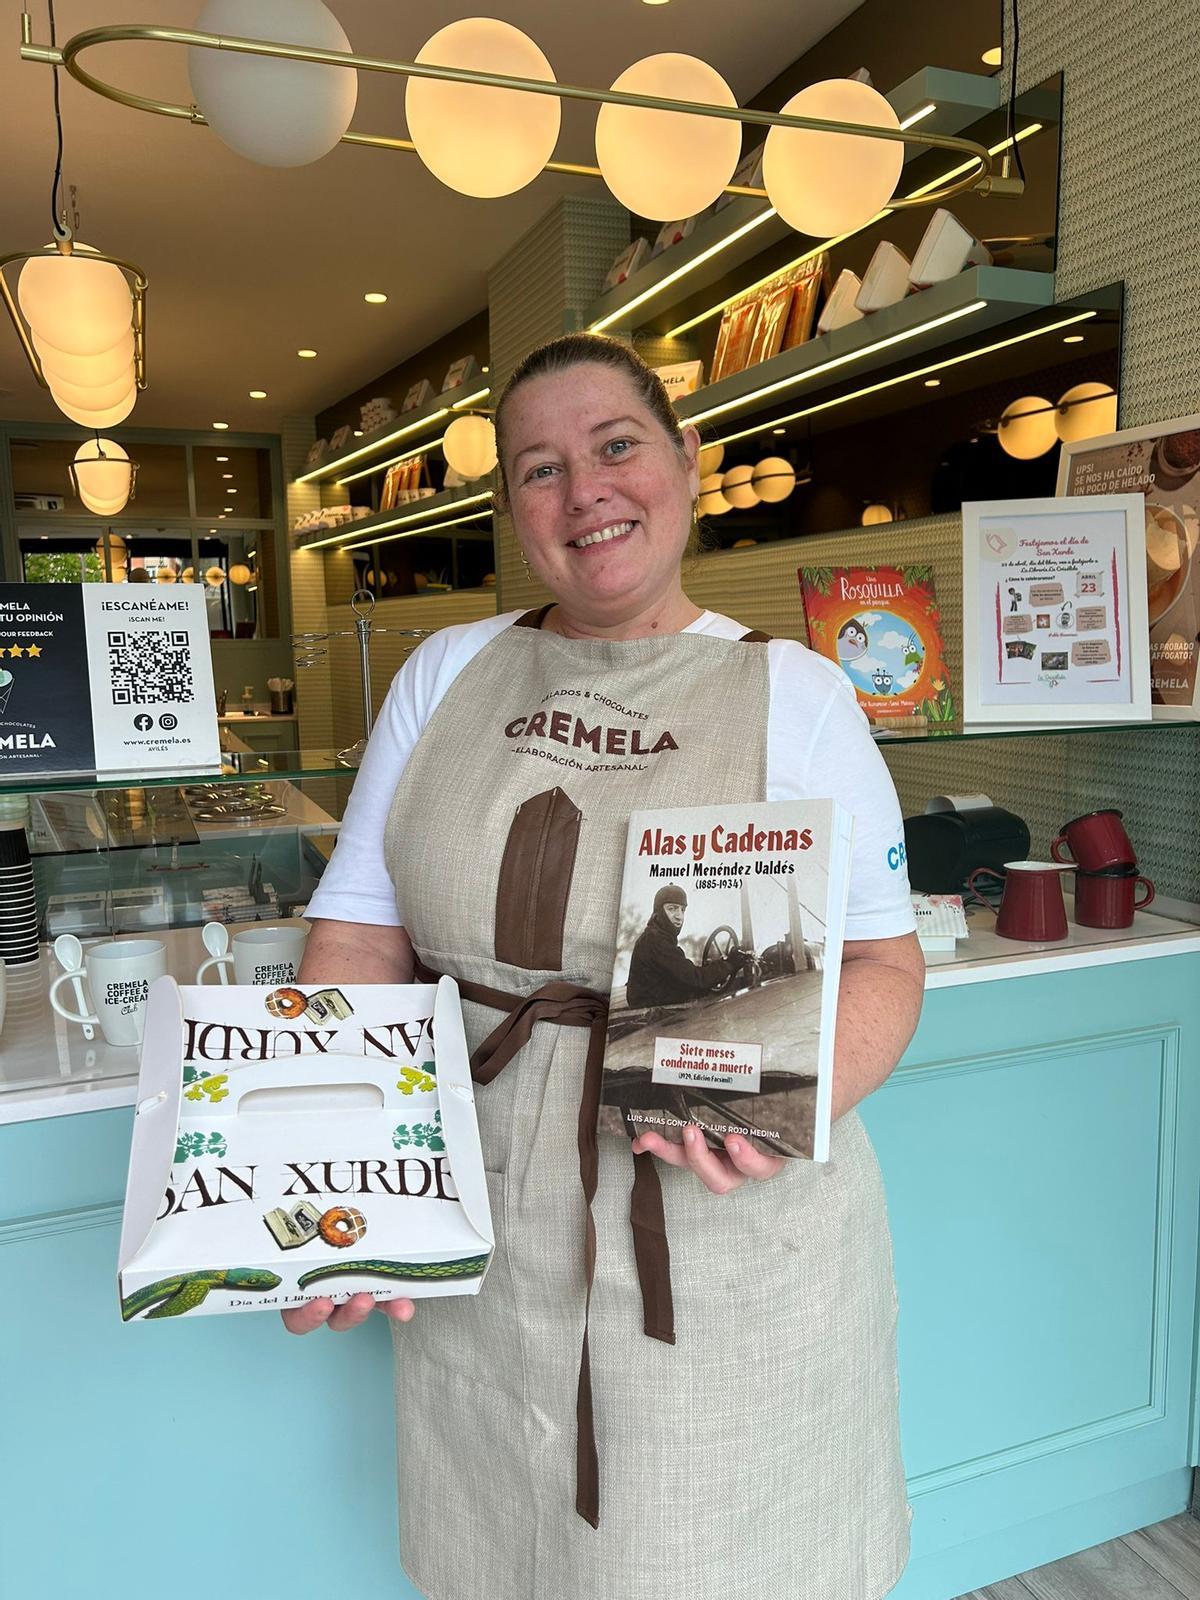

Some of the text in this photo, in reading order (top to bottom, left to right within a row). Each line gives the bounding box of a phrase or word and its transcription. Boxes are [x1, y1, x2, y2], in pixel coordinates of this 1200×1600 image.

[1075, 464, 1143, 486] SE NOS HA CAÍDO
[1076, 464, 1094, 474] UPS!
[1074, 487, 1084, 496] UN
[1086, 483, 1107, 494] POCO
[1109, 480, 1120, 490] DE
[1122, 474, 1155, 489] HELADO
[1019, 538, 1058, 549] Festejamos
[1036, 548, 1051, 556] San
[1081, 583, 1097, 593] 23
[101, 598, 189, 611] ¡ESCANÉAME!
[0, 611, 64, 622] TU OPINIÓN
[1160, 642, 1194, 651] PROBADO
[1152, 651, 1193, 660] AFFOGATO?
[593, 692, 650, 720] CHOCOLATES
[504, 710, 679, 756] CREMELA
[123, 736, 191, 746] www.cremela.es
[584, 764, 648, 772] ARTESANAL-
[638, 823, 814, 861] Alas y Cadenas
[649, 860, 795, 878] Manuel Menéndez Valdés
[695, 878, 743, 890] (1885-1934)
[255, 962, 294, 973] CREMELA
[255, 968, 294, 980] COFFEE &
[106, 979, 149, 991] CREMELA
[107, 986, 149, 998] COFFEE &
[358, 1016, 435, 1058] AN
[680, 1043, 736, 1060] Siete meses
[661, 1056, 754, 1075] condenado a muerte
[627, 1114, 643, 1122] LUIS
[643, 1117, 666, 1126] ARIAS
[710, 1123, 727, 1133] LUIS
[728, 1126, 749, 1135] ROJO
[750, 1128, 781, 1139] MEDINA
[258, 1296, 278, 1305] del
